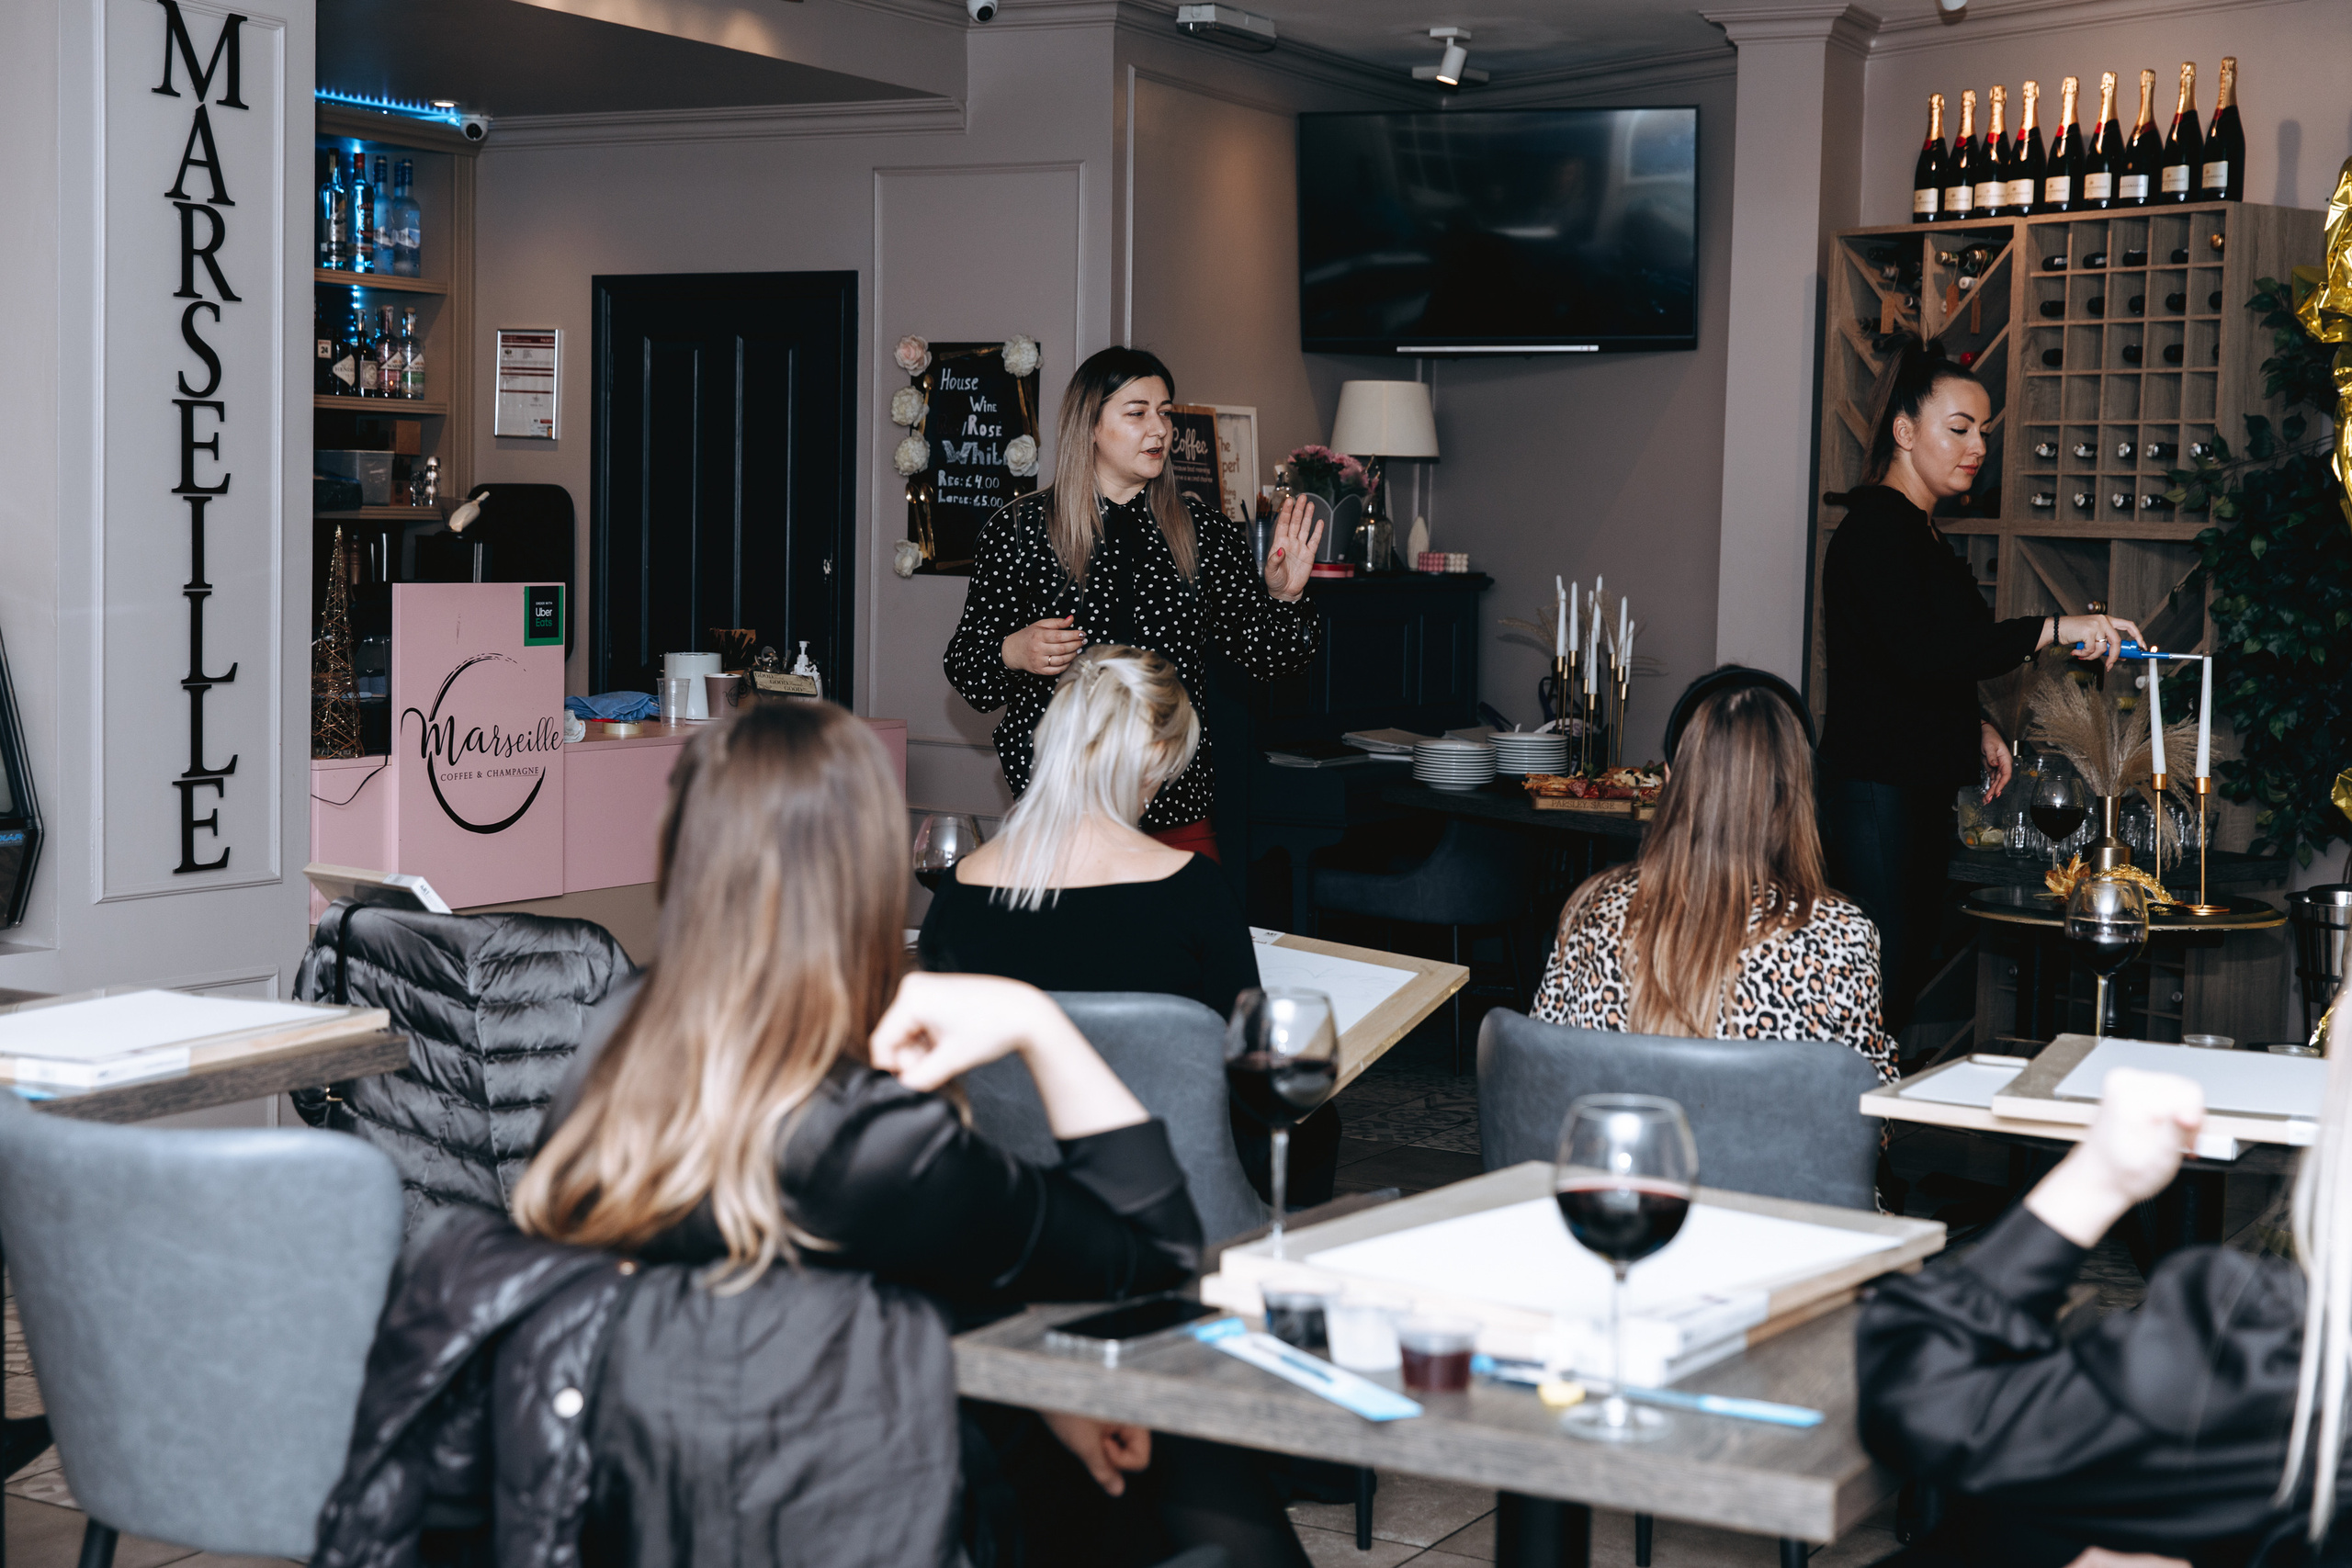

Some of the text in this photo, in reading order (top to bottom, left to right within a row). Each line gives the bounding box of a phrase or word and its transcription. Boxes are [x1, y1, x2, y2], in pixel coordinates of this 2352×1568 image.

[940, 368, 979, 390] House
[152, 0, 249, 874] MARSEILLE
[1222, 452, 1240, 479] pert
[535, 607, 553, 616] Uber
[535, 617, 553, 627] Eats
[401, 707, 564, 766] Marseille
[440, 766, 540, 782] COFFEE & CHAMPAGNE
